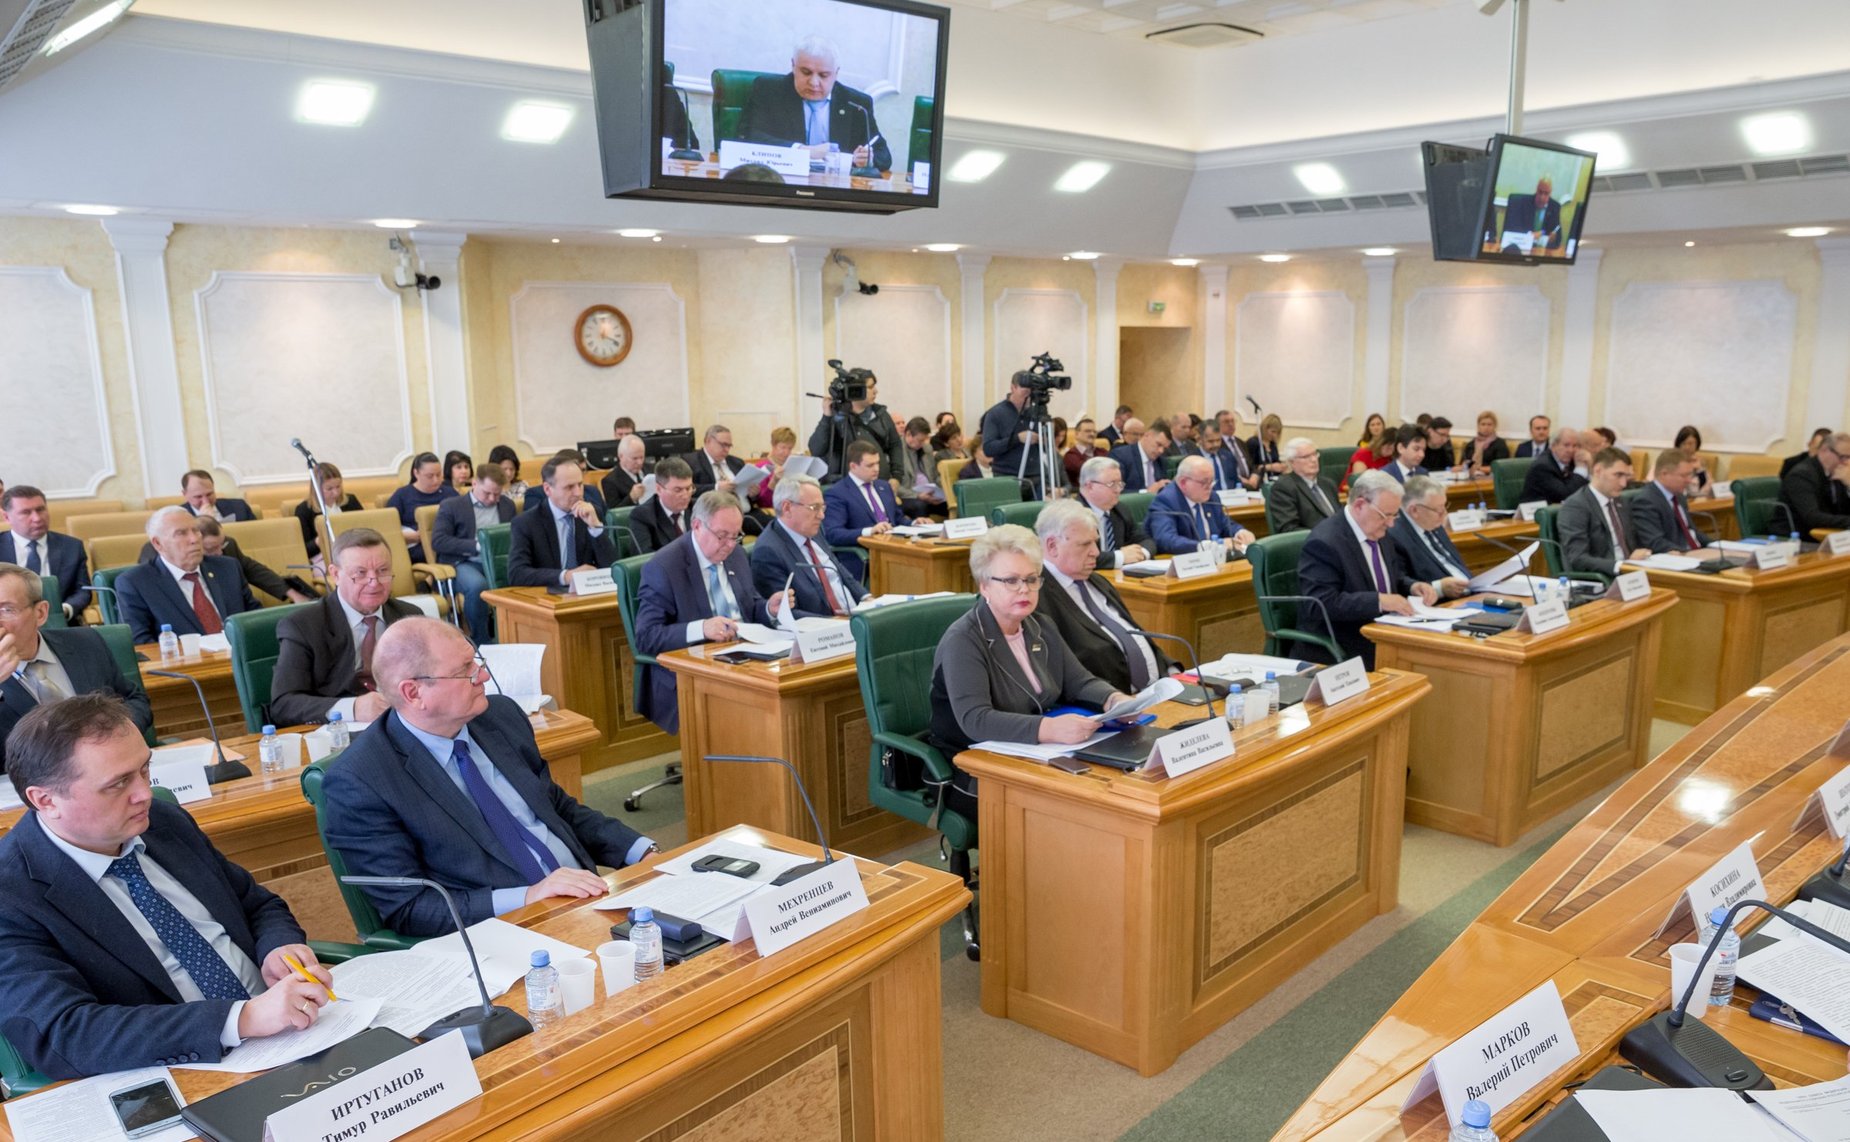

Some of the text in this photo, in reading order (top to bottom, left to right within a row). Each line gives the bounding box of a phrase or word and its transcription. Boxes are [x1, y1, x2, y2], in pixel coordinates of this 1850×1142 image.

[769, 889, 853, 936] Андрей Вениаминович
[777, 880, 834, 914] МЕХРЕНЦЕВ
[1481, 1020, 1532, 1064] МАРКОВ
[280, 1066, 357, 1098] VAIO
[1466, 1032, 1560, 1102] Валерий Петрович
[330, 1067, 425, 1121] ИРТУГАНОВ
[370, 1080, 446, 1125] Равильевич
